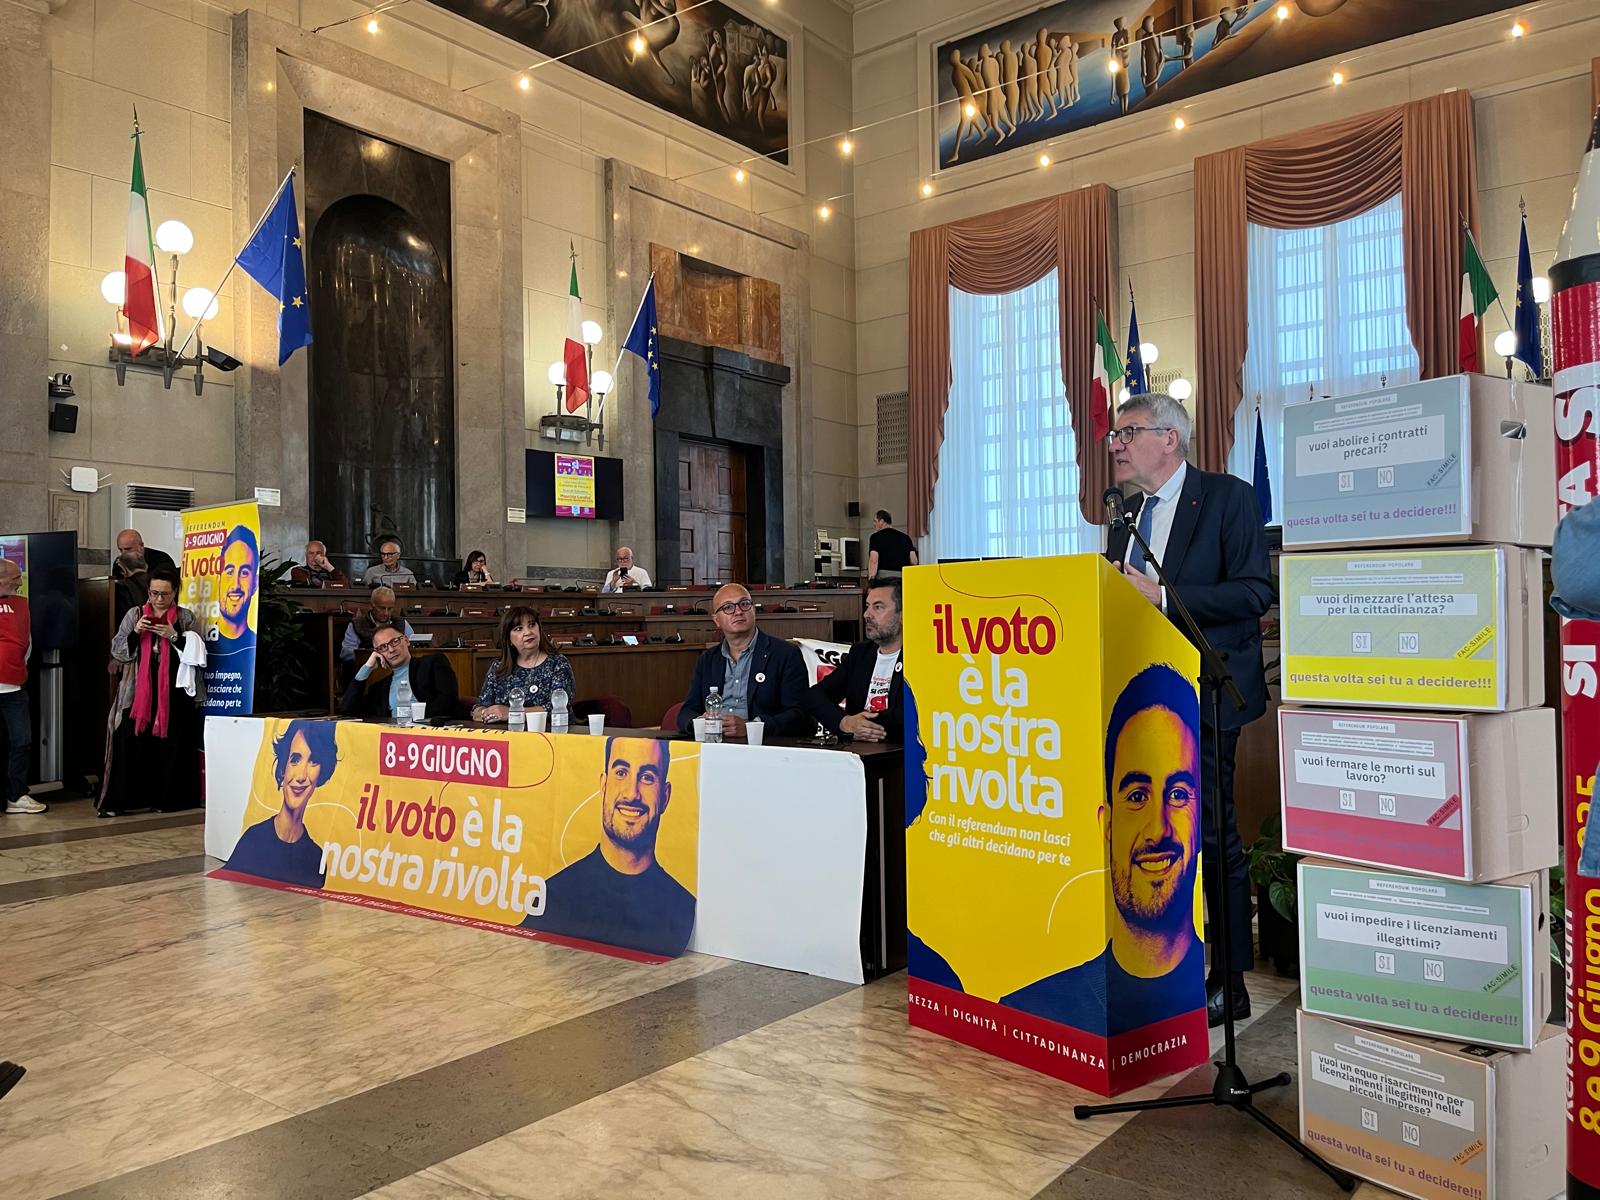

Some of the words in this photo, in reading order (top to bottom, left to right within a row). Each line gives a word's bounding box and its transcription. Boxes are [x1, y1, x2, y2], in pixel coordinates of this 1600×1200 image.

[1309, 438, 1329, 452] vuoi
[1333, 435, 1369, 448] abolire
[1372, 433, 1375, 442] i
[1378, 425, 1427, 441] contratti
[1344, 443, 1387, 459] precari?
[1341, 475, 1351, 488] SI
[1379, 469, 1392, 484] NO
[1426, 453, 1456, 486] FAC-SIMILE
[1287, 515, 1320, 528] questa
[1323, 513, 1348, 524] volta
[1351, 511, 1366, 522] sei
[1369, 510, 1380, 520] tu
[1384, 511, 1390, 519] a
[1393, 504, 1456, 518] decidere!!!
[197, 532, 224, 545] GIUGNO
[182, 553, 188, 578] il
[191, 553, 225, 576] voto
[188, 576, 197, 598] è
[200, 576, 211, 597] la
[1316, 594, 1340, 604] vuoi
[1343, 593, 1403, 604] dimezzare
[1407, 593, 1454, 603] l'attesa
[1327, 605, 1346, 615] per
[1350, 604, 1360, 614] la
[1363, 604, 1445, 615] cittadinanza?
[933, 603, 958, 654] il
[961, 606, 1056, 655] voto
[1356, 636, 1367, 649] SI
[1401, 636, 1416, 649] NO
[1457, 627, 1491, 658] FAC-SIMILE
[215, 671, 242, 681] impegno,
[959, 654, 983, 705] è
[992, 653, 1028, 707] la
[1290, 672, 1329, 684] questa
[1334, 674, 1364, 684] volta
[1367, 674, 1384, 684] sei
[1389, 675, 1402, 685] tu
[1406, 678, 1413, 686] a
[1418, 677, 1491, 688] decidere!!!
[1563, 645, 1597, 698] SI
[208, 684, 232, 693] lasciare
[233, 685, 242, 693] che
[225, 699, 234, 708] per
[236, 699, 241, 707] te
[932, 707, 1061, 760] nostra
[422, 744, 501, 778] GIUGNO
[1302, 756, 1323, 767] vuoi
[1326, 757, 1367, 771] fermare
[1371, 762, 1381, 772] le
[1384, 763, 1414, 775] morti
[1418, 766, 1435, 777] sul
[932, 748, 1063, 818] rivolta
[1347, 771, 1386, 784] lavoro?
[1342, 793, 1352, 807] SI
[1381, 797, 1394, 812] NO
[356, 783, 379, 831] il
[385, 795, 455, 842] voto
[463, 796, 483, 847] è
[492, 799, 523, 852] la
[929, 811, 946, 825] Con
[949, 814, 955, 827] il
[957, 818, 1016, 837] referendum
[1020, 829, 1040, 841] non
[1043, 830, 1071, 846] lasci
[929, 829, 945, 842] che
[947, 833, 960, 847] gli
[962, 836, 984, 850] altri
[986, 839, 1035, 859] decidano
[1038, 850, 1056, 864] per
[1059, 853, 1071, 865] te
[319, 842, 424, 890] nostra
[426, 847, 546, 916] rivolta
[1324, 910, 1348, 921] vuoi
[1351, 912, 1403, 929] impedire
[1407, 919, 1411, 929] i
[1413, 921, 1497, 941] licenziamenti
[1377, 932, 1441, 950] illegittimi?
[1379, 955, 1392, 970] SI
[1427, 964, 1441, 978] NO
[1484, 964, 1517, 993] FAC-SIMILE
[1310, 985, 1352, 1000] questa
[1356, 990, 1388, 1005] volta
[1392, 998, 1411, 1009] sei
[1415, 1001, 1427, 1012] tu
[1432, 1005, 1439, 1014] a
[1443, 1006, 1518, 1026] decidere!!!
[953, 1008, 997, 1032] DIGNITÀ
[1013, 1029, 1105, 1069] CITTADINANZA
[1121, 1034, 1188, 1066] DEMOCRAZIA
[1361, 1039, 1389, 1051] REFERENDUM
[1579, 1039, 1600, 1067] 9
[1319, 1056, 1338, 1067] vuoi
[1340, 1061, 1351, 1072] un
[1355, 1068, 1378, 1080] equo
[1380, 1076, 1444, 1101] risarcimento
[1447, 1096, 1464, 1107] per
[1320, 1064, 1382, 1091] licenziamenti
[1385, 1084, 1432, 1107] illegittimi
[1436, 1101, 1461, 1116] nelle
[1350, 1084, 1383, 1101] piccole
[1385, 1096, 1431, 1116] imprese?
[1364, 1113, 1375, 1127] SI
[1404, 1126, 1418, 1142] NO
[1308, 1129, 1342, 1149] questa
[1346, 1145, 1372, 1160] volta
[1375, 1157, 1391, 1167] sei
[1394, 1162, 1405, 1172] tu
[1408, 1168, 1415, 1176] a
[1418, 1170, 1482, 1200] decidere!!!
[1454, 1140, 1483, 1162] FAC-SIMILE
